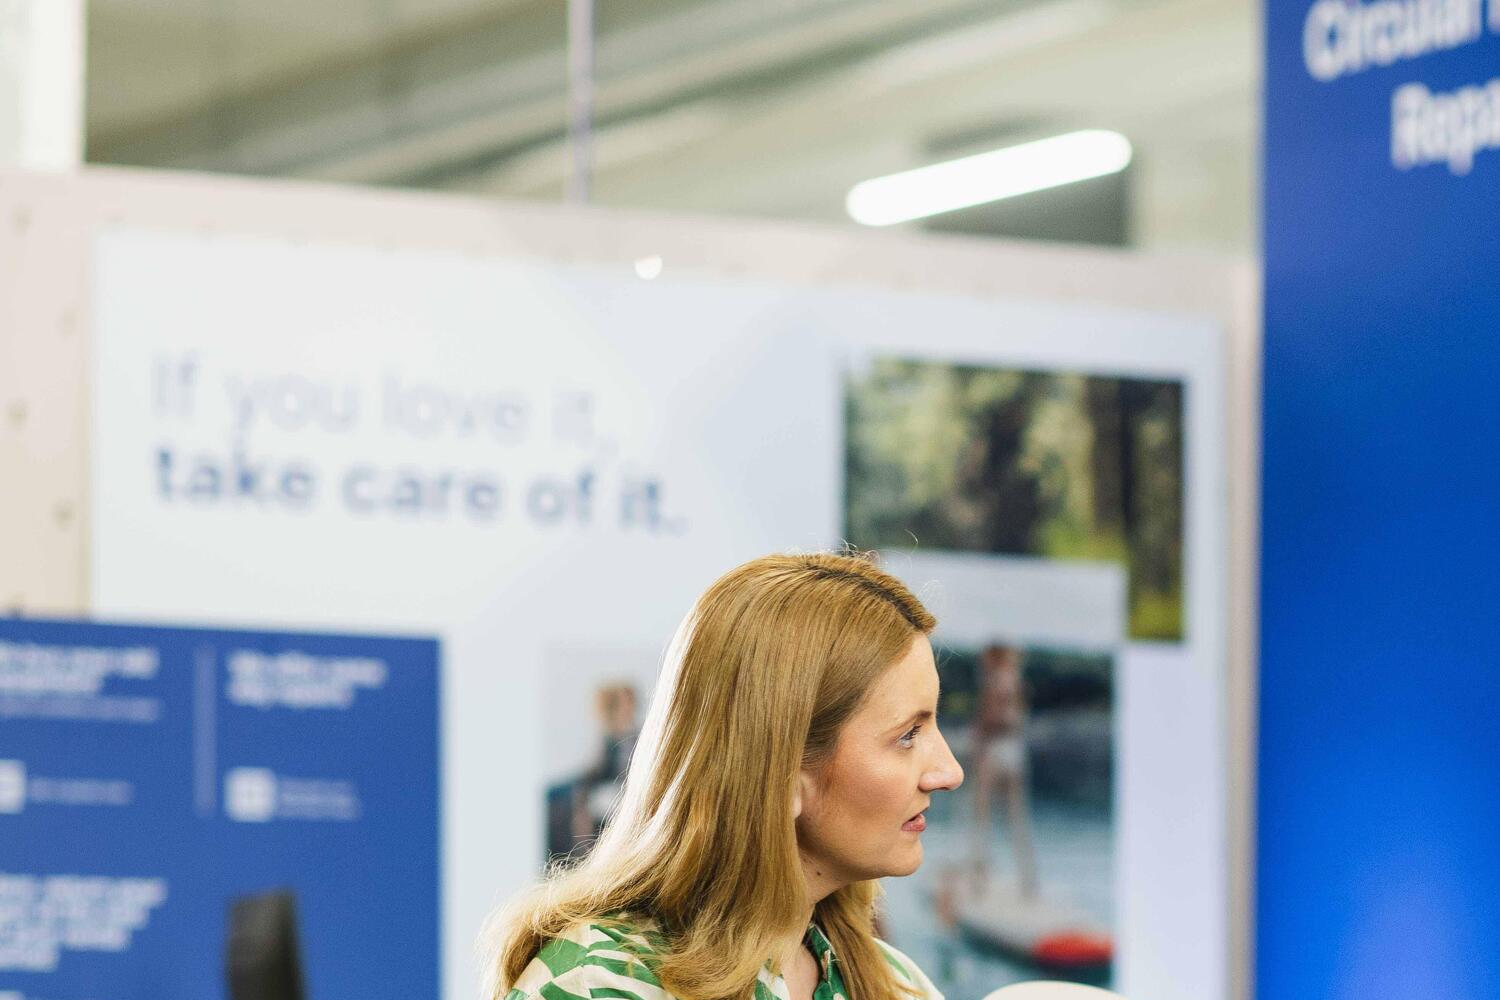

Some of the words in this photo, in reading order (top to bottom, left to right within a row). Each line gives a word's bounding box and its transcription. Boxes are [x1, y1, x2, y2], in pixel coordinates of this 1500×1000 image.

[224, 370, 360, 450] you
[152, 446, 318, 514] take
[340, 462, 506, 526] care
[525, 464, 598, 528] of
[616, 470, 692, 536] it.
